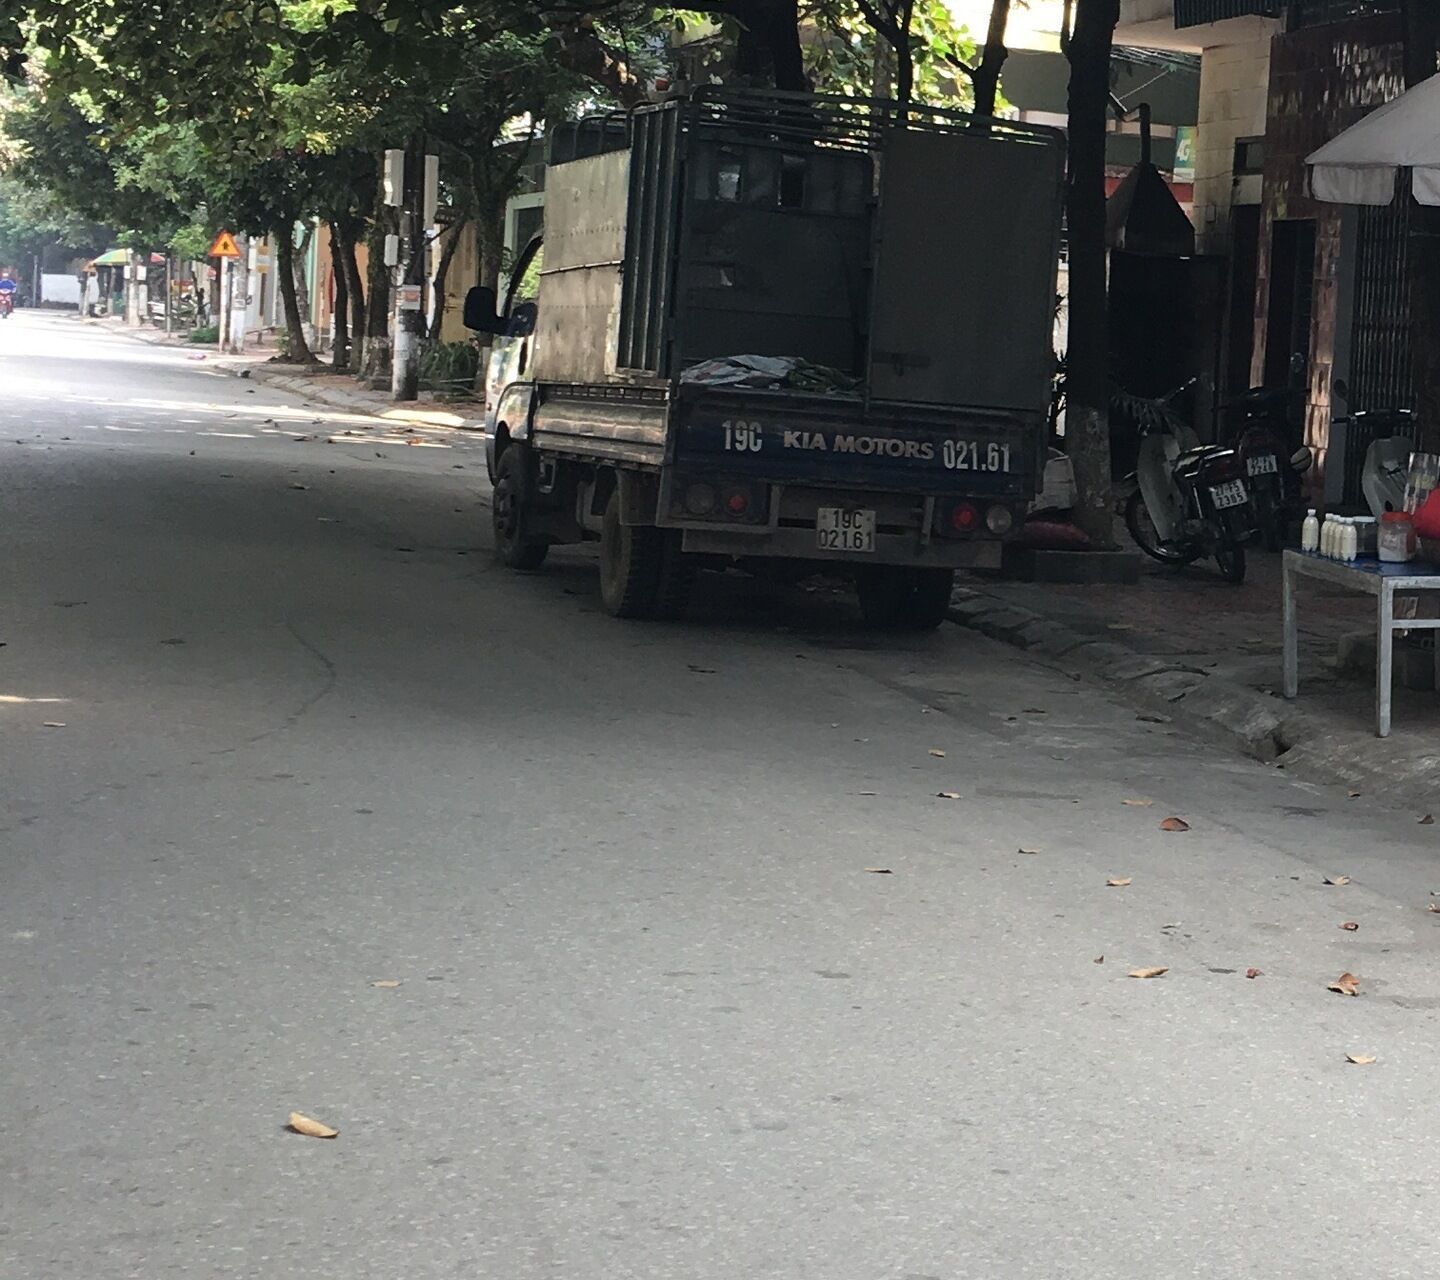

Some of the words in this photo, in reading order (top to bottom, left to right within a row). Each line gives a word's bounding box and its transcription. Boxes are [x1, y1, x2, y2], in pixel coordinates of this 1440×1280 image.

[722, 421, 763, 452] 19C
[783, 430, 828, 451] KIA
[832, 434, 935, 460] MOTORS
[943, 439, 1010, 473] 021.61
[832, 508, 863, 530] 19C
[817, 528, 873, 551] 021.61
